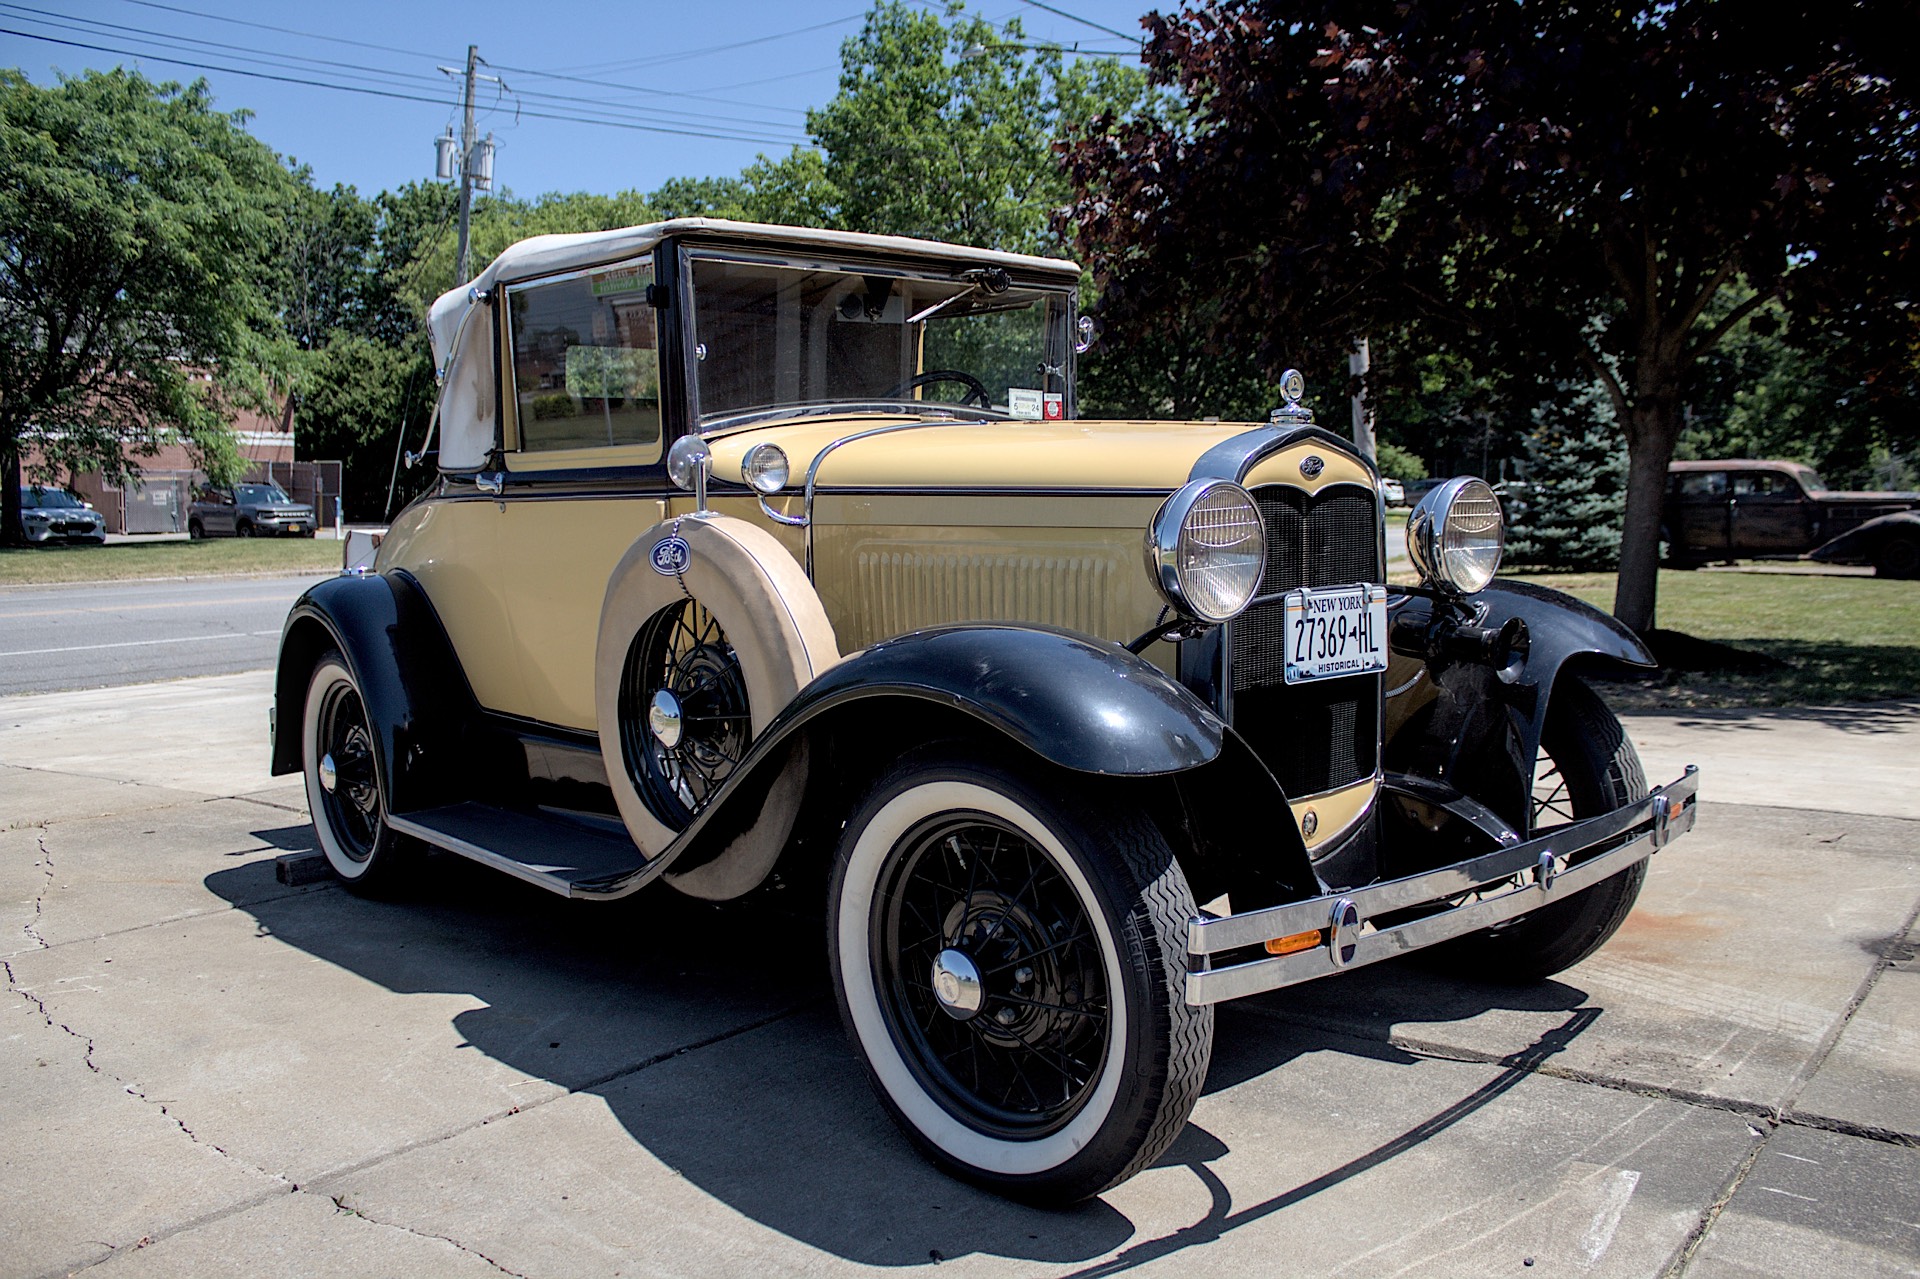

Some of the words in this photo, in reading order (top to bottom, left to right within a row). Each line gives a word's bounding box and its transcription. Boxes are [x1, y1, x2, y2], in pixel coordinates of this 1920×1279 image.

[1031, 404, 1040, 412] 24
[1313, 598, 1336, 614] NEW
[1338, 595, 1363, 611] YORK
[1295, 614, 1347, 662] 27369
[1358, 612, 1379, 654] HL
[1318, 659, 1360, 673] HISTORICAL
